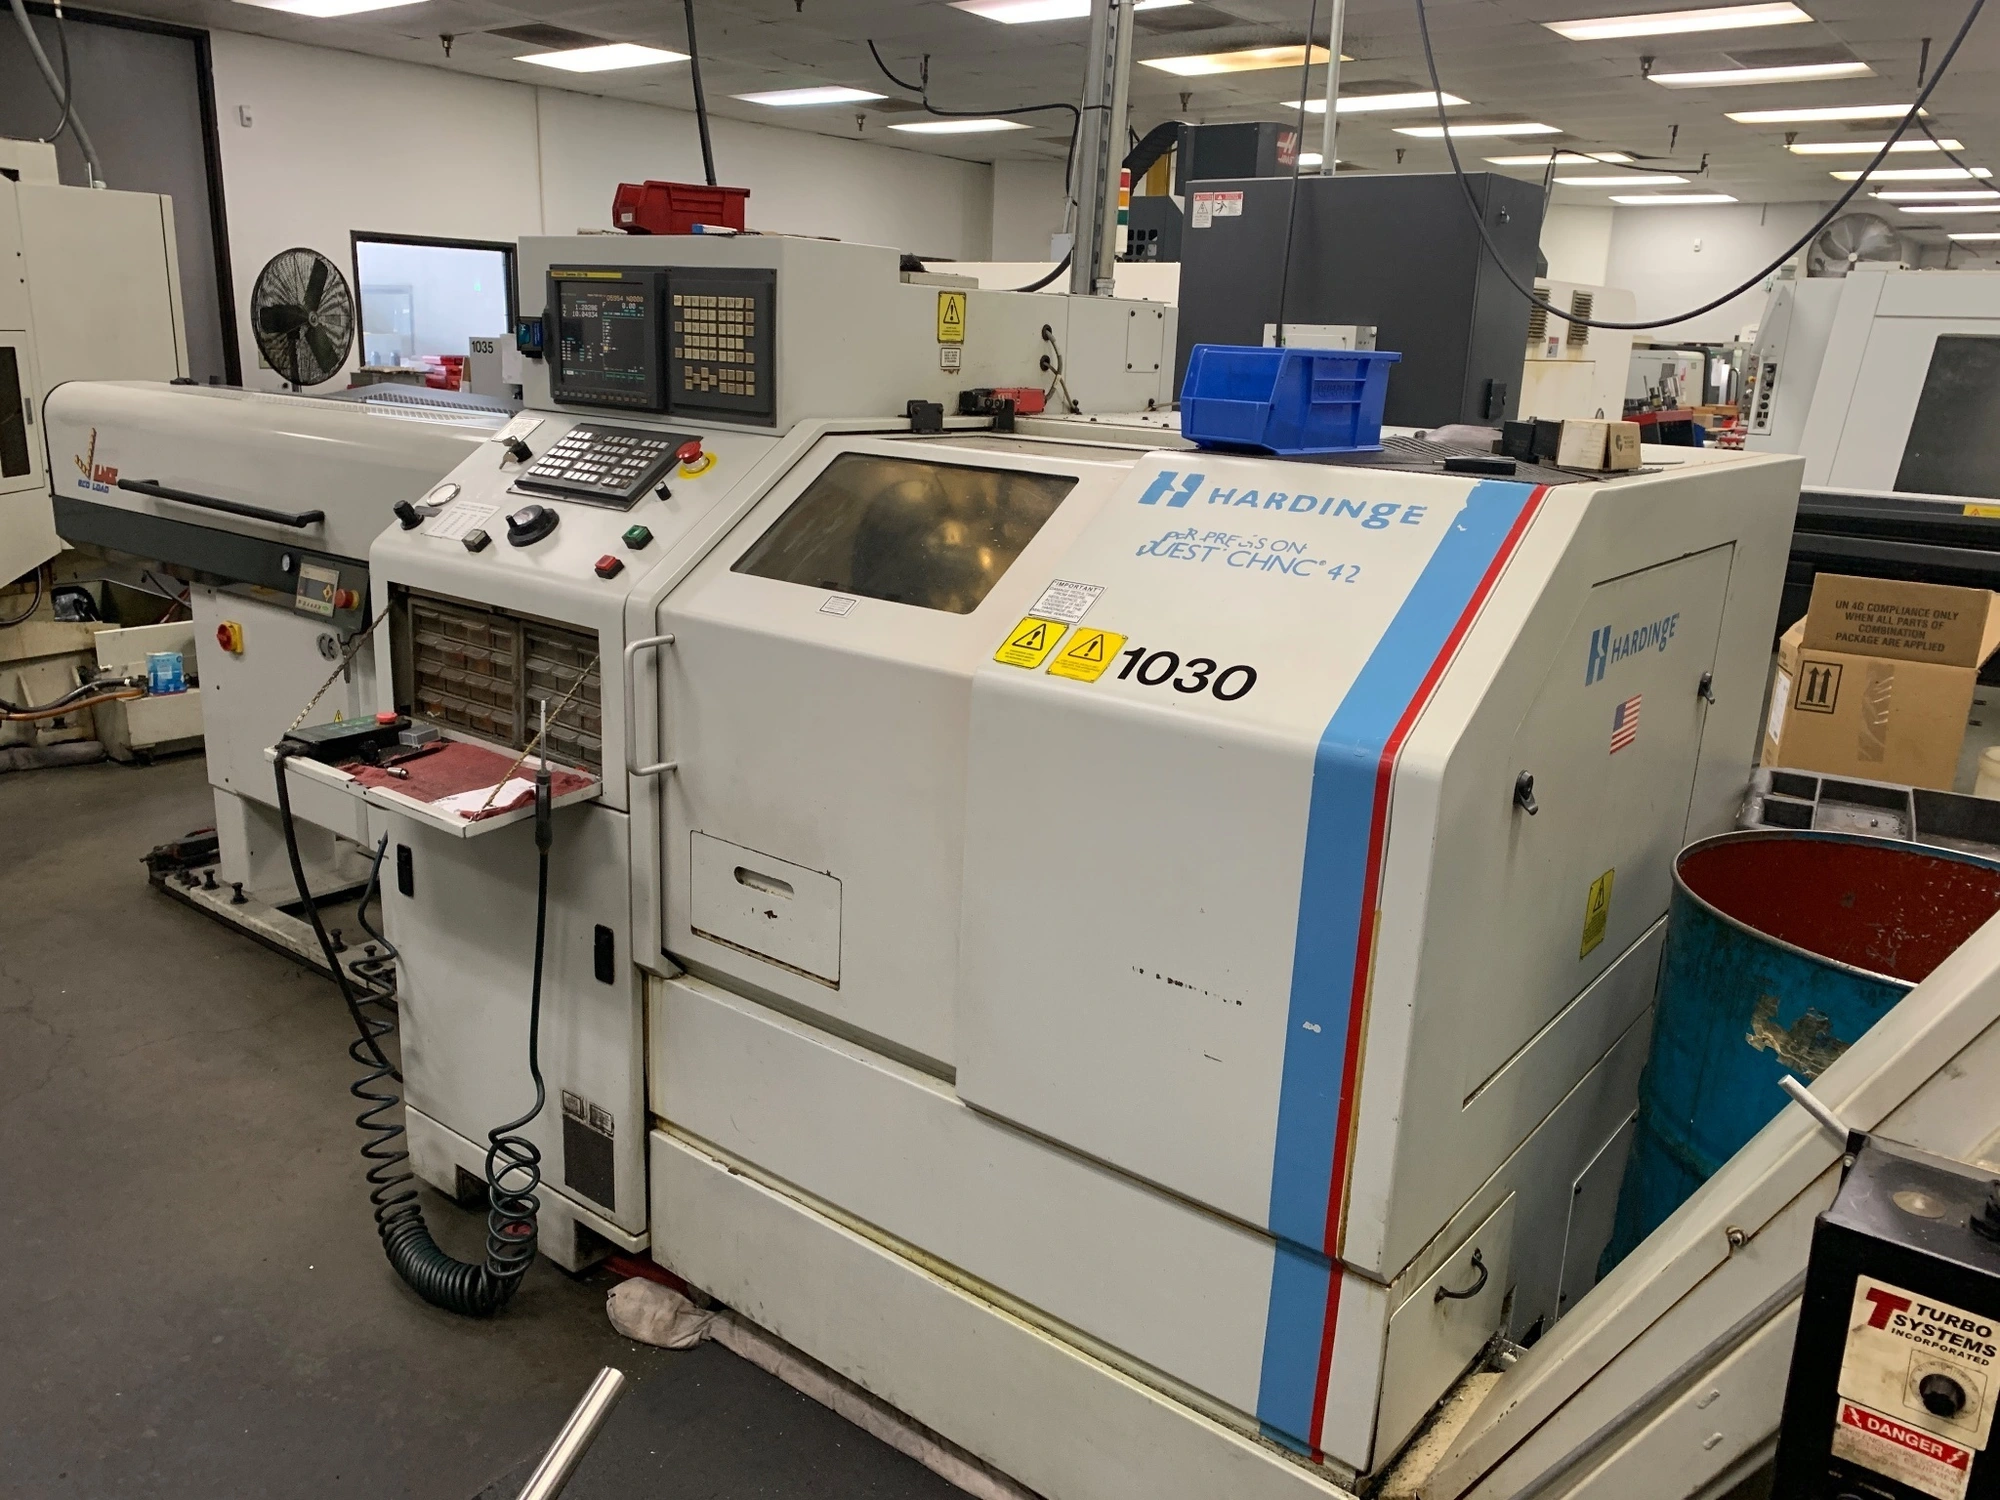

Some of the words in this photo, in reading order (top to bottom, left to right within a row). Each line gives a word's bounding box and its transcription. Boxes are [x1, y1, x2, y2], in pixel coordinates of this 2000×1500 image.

[472, 340, 494, 354] 1035
[1328, 564, 1361, 584] 42
[1835, 600, 1849, 609] UN
[1852, 601, 1863, 610] 4G
[1866, 602, 1930, 618] COMPLIANCE
[1932, 609, 1959, 620] ONLY
[1845, 612, 1874, 622] WHEN
[1876, 615, 1894, 625] ALL
[1898, 616, 1928, 628] PARTS
[1931, 619, 1944, 629] OF
[1858, 624, 1926, 639] COMBINATION
[1835, 633, 1879, 645] PACKAGE
[1882, 637, 1900, 647] ARE
[1904, 639, 1945, 652] APPLIED
[1117, 646, 1258, 701] 1030
[1916, 1303, 1992, 1338] TURBO
[1893, 1314, 1997, 1358] SYSTEMS
[1891, 1328, 1990, 1367] INCORPORATED
[1867, 1417, 1944, 1458] DANGER
